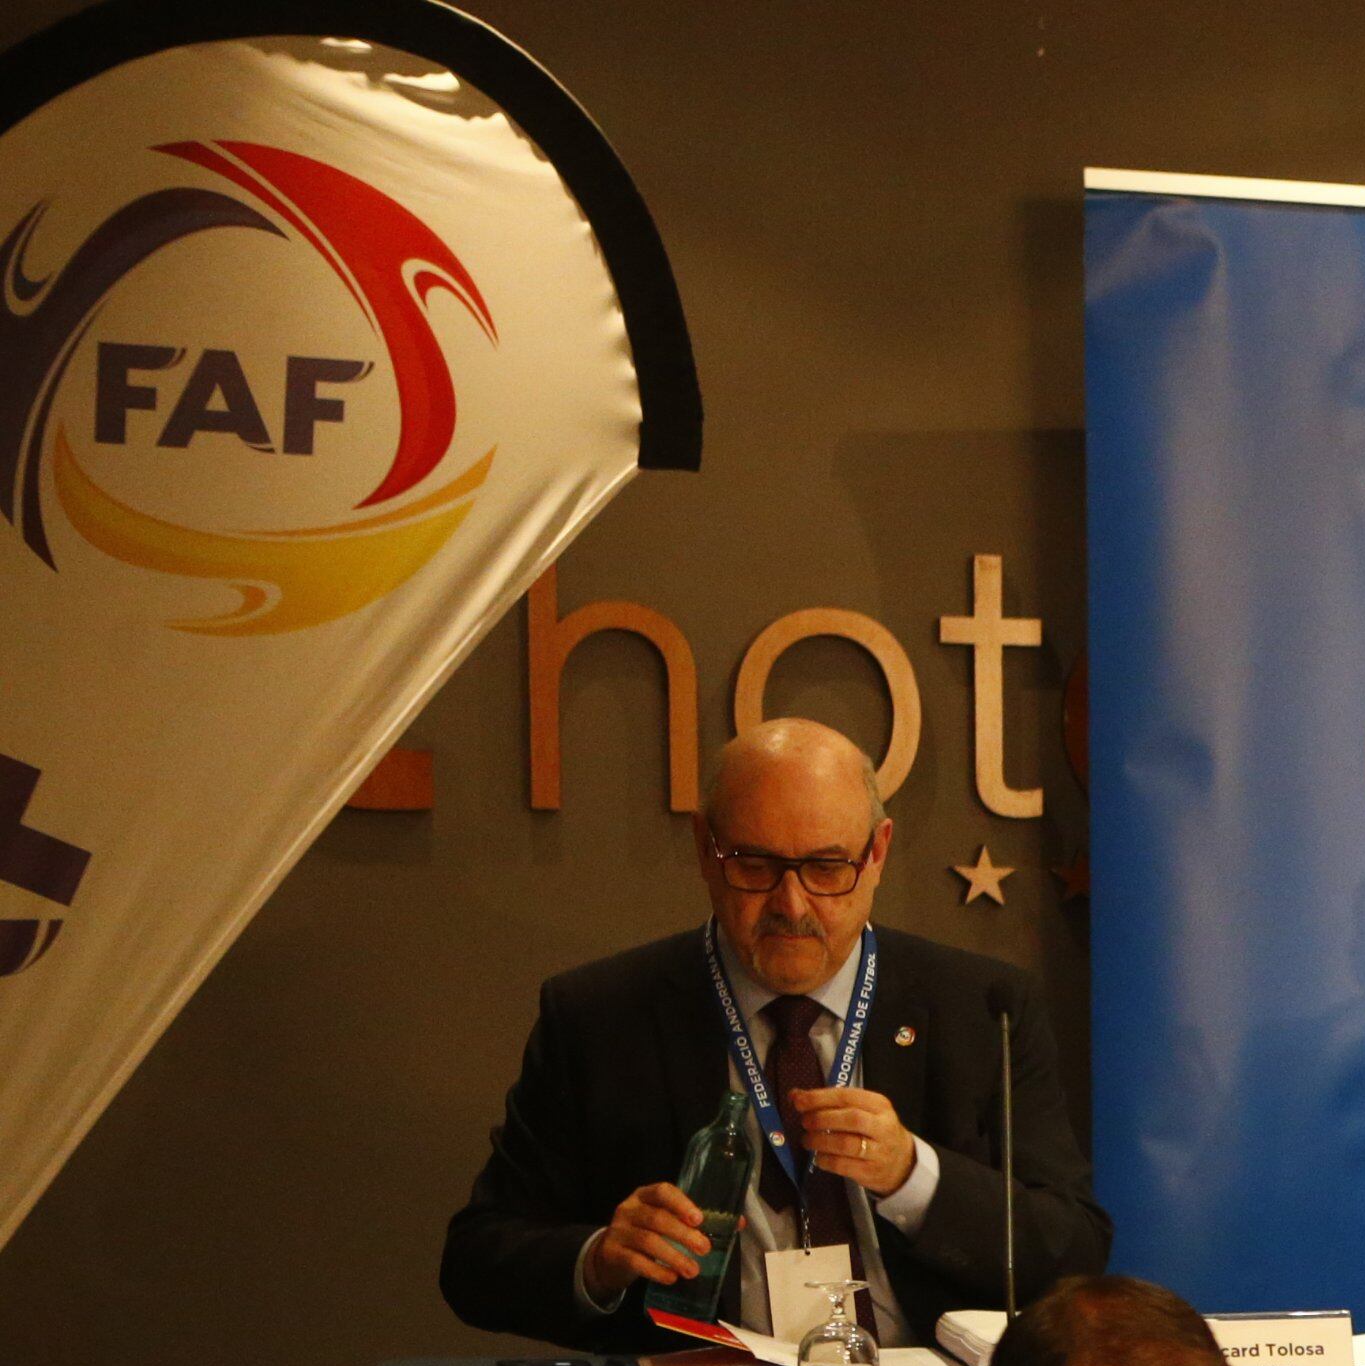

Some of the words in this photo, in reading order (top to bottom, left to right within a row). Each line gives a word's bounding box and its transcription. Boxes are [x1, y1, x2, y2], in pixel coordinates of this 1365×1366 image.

[95, 342, 374, 456] FAF
[528, 554, 1088, 818] hot
[860, 952, 876, 1000] FUTBOL
[856, 1000, 869, 1019] DE
[836, 1018, 864, 1089] NDORRANA
[1222, 1343, 1260, 1358] card
[1266, 1342, 1325, 1357] Tolosa
